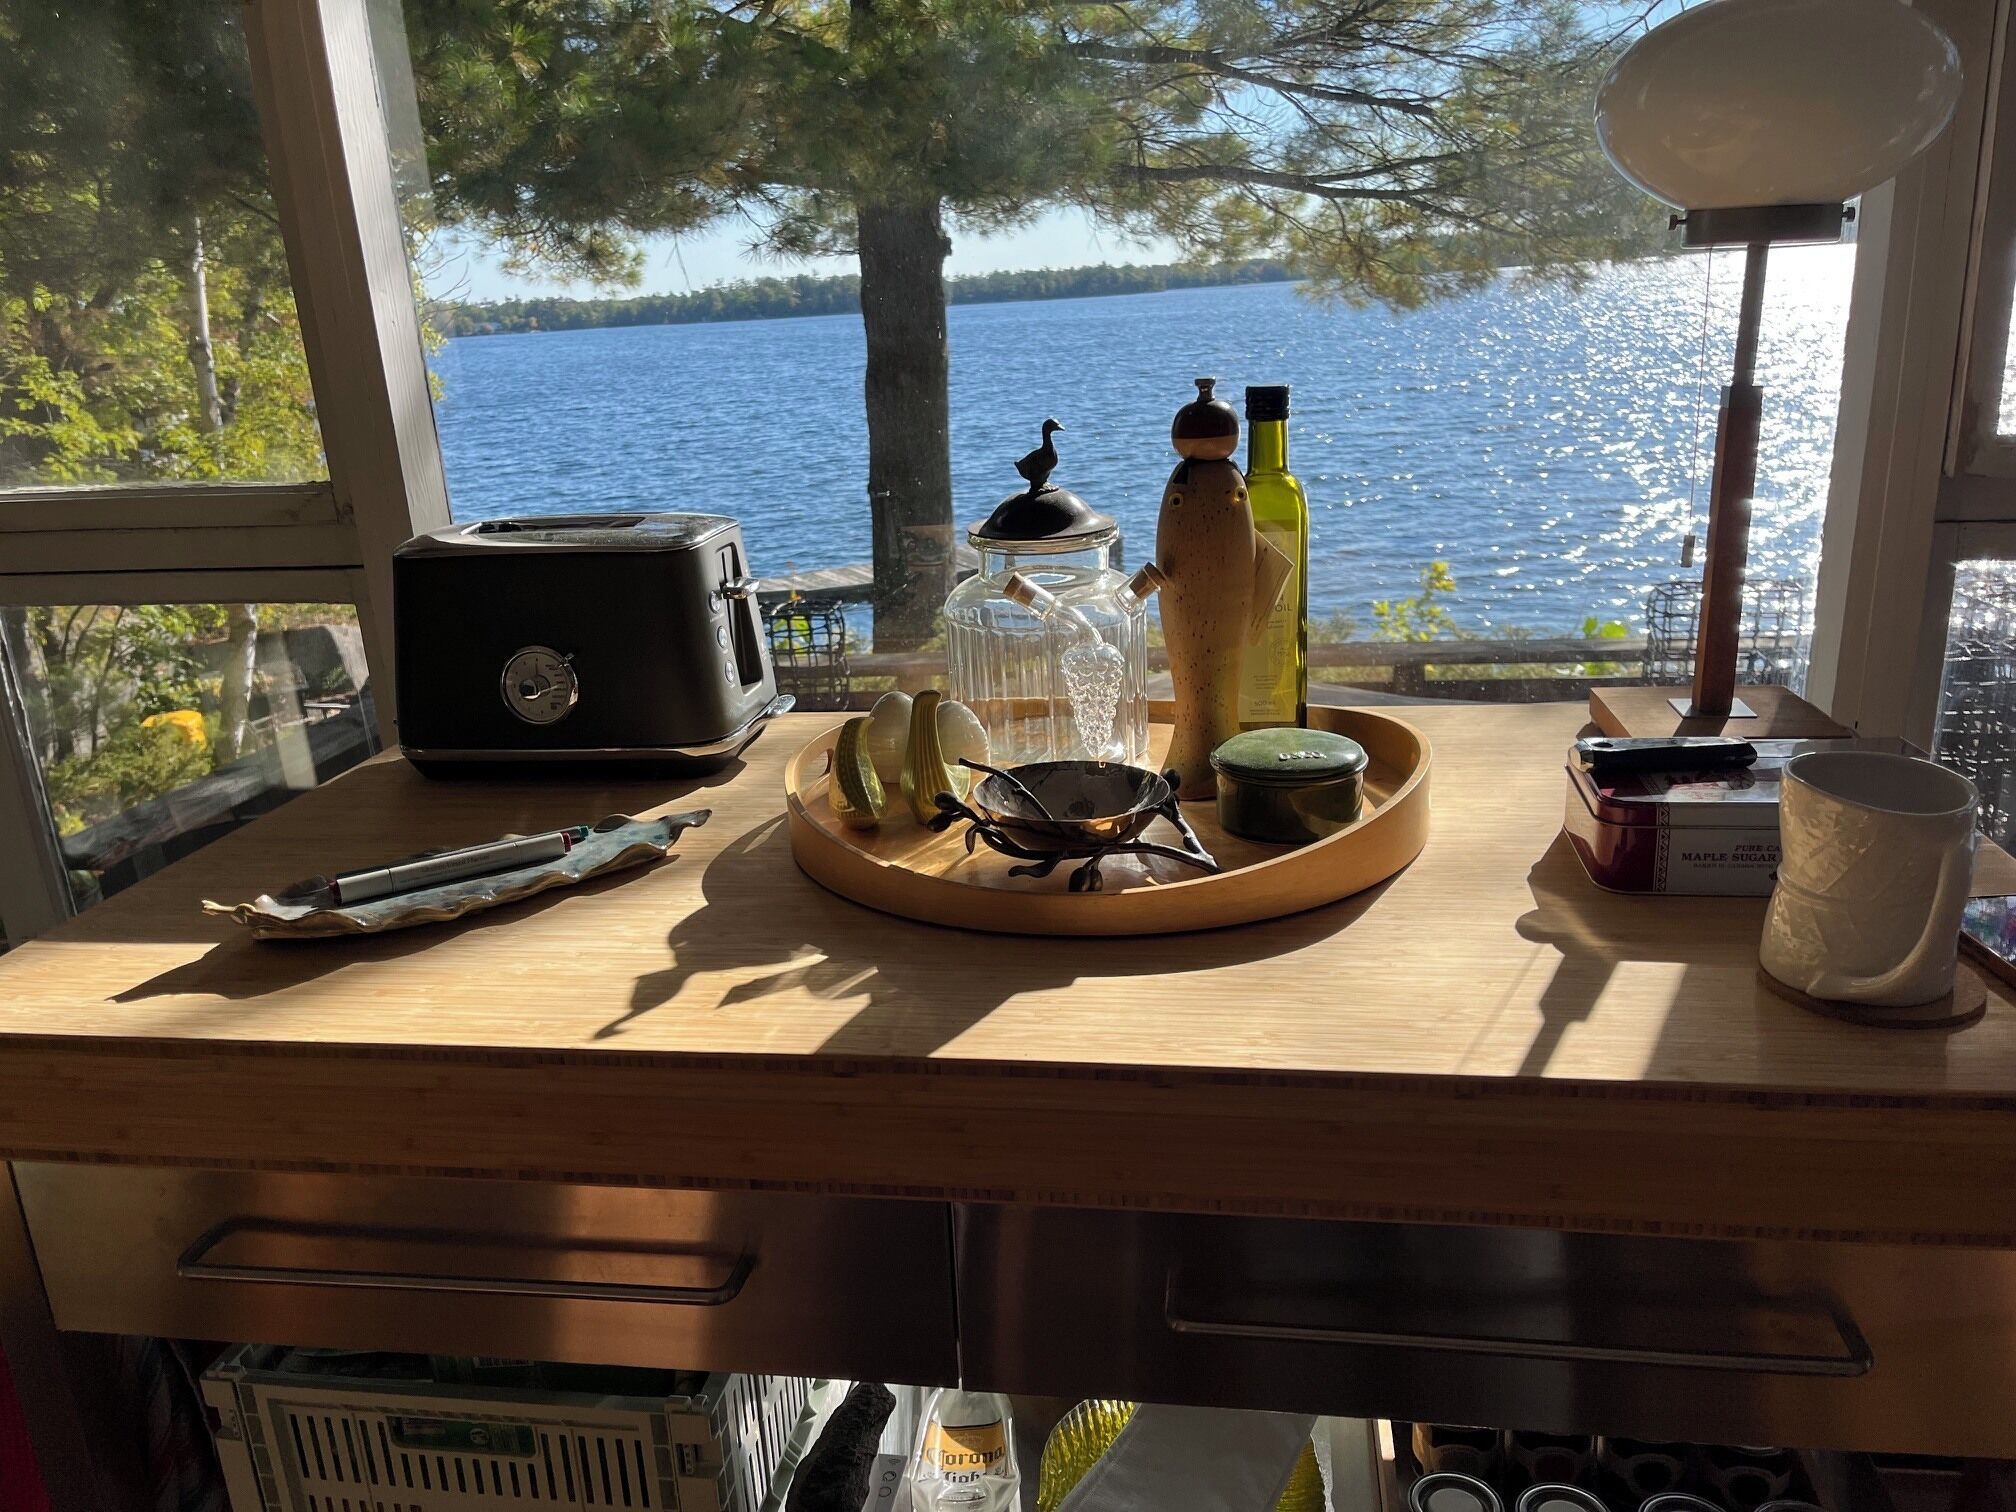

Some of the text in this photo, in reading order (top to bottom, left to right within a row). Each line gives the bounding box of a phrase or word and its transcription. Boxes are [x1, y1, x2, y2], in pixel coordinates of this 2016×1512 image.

[1275, 603, 1293, 611] OIL
[1734, 844, 1763, 852] PURE
[1681, 852, 1776, 862] MAPLE SUGAR
[926, 1447, 1004, 1470] Corona
[942, 1471, 986, 1484] Ligh
